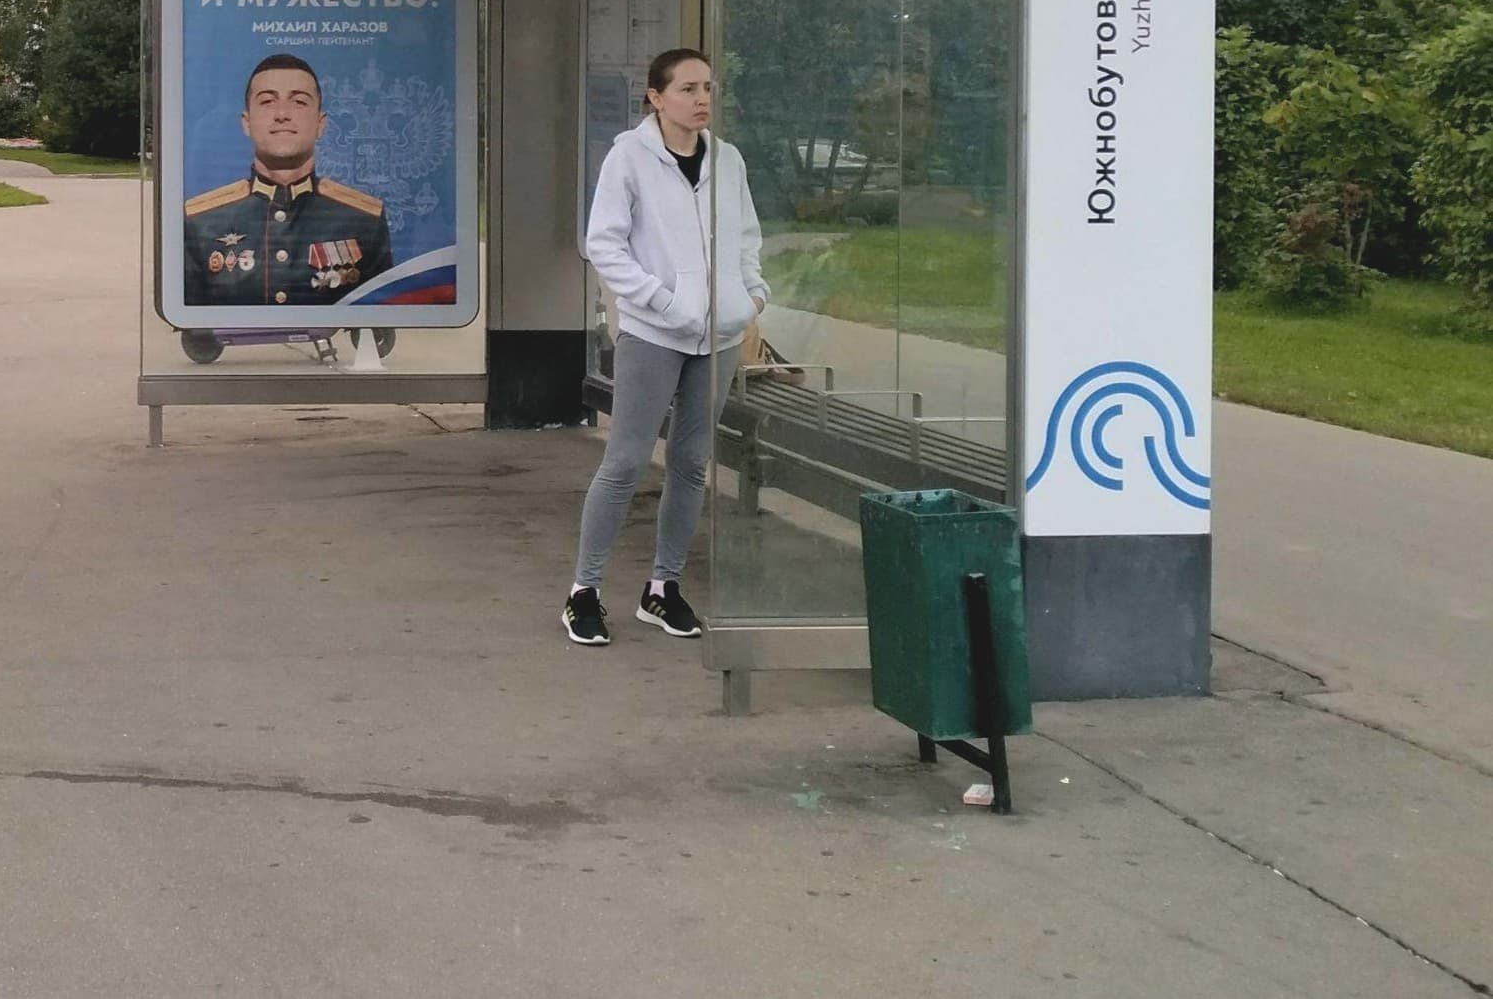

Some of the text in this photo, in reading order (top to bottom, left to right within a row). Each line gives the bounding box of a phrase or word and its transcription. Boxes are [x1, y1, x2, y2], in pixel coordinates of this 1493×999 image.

[252, 21, 388, 33] МИХАИЛ ХАРАЗОВ
[265, 35, 316, 46] СТАРШИЙ
